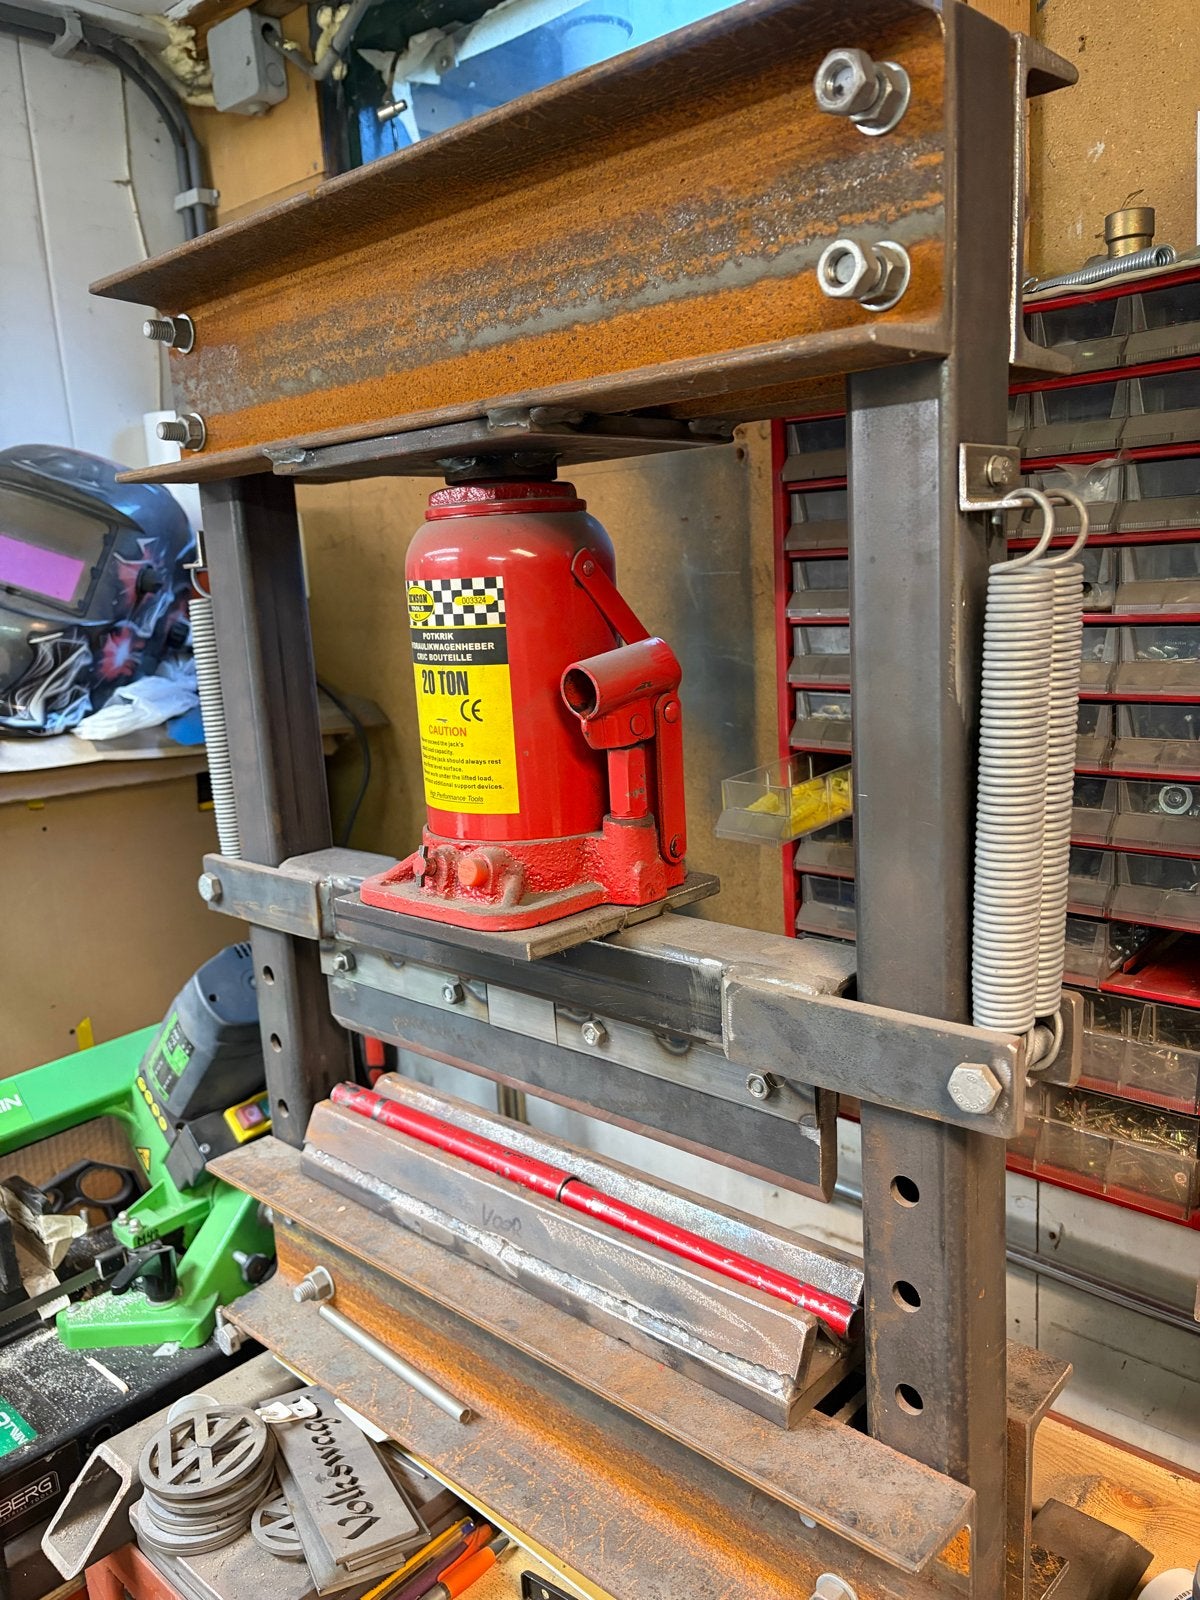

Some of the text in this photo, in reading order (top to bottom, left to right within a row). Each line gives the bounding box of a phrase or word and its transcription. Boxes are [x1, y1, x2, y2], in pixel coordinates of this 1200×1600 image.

[461, 596, 487, 605] 003324
[422, 632, 454, 640] POTKRIK
[429, 653, 473, 662] BOUTEILLE
[421, 669, 469, 696] 20 TON
[428, 724, 467, 737] CAUTION
